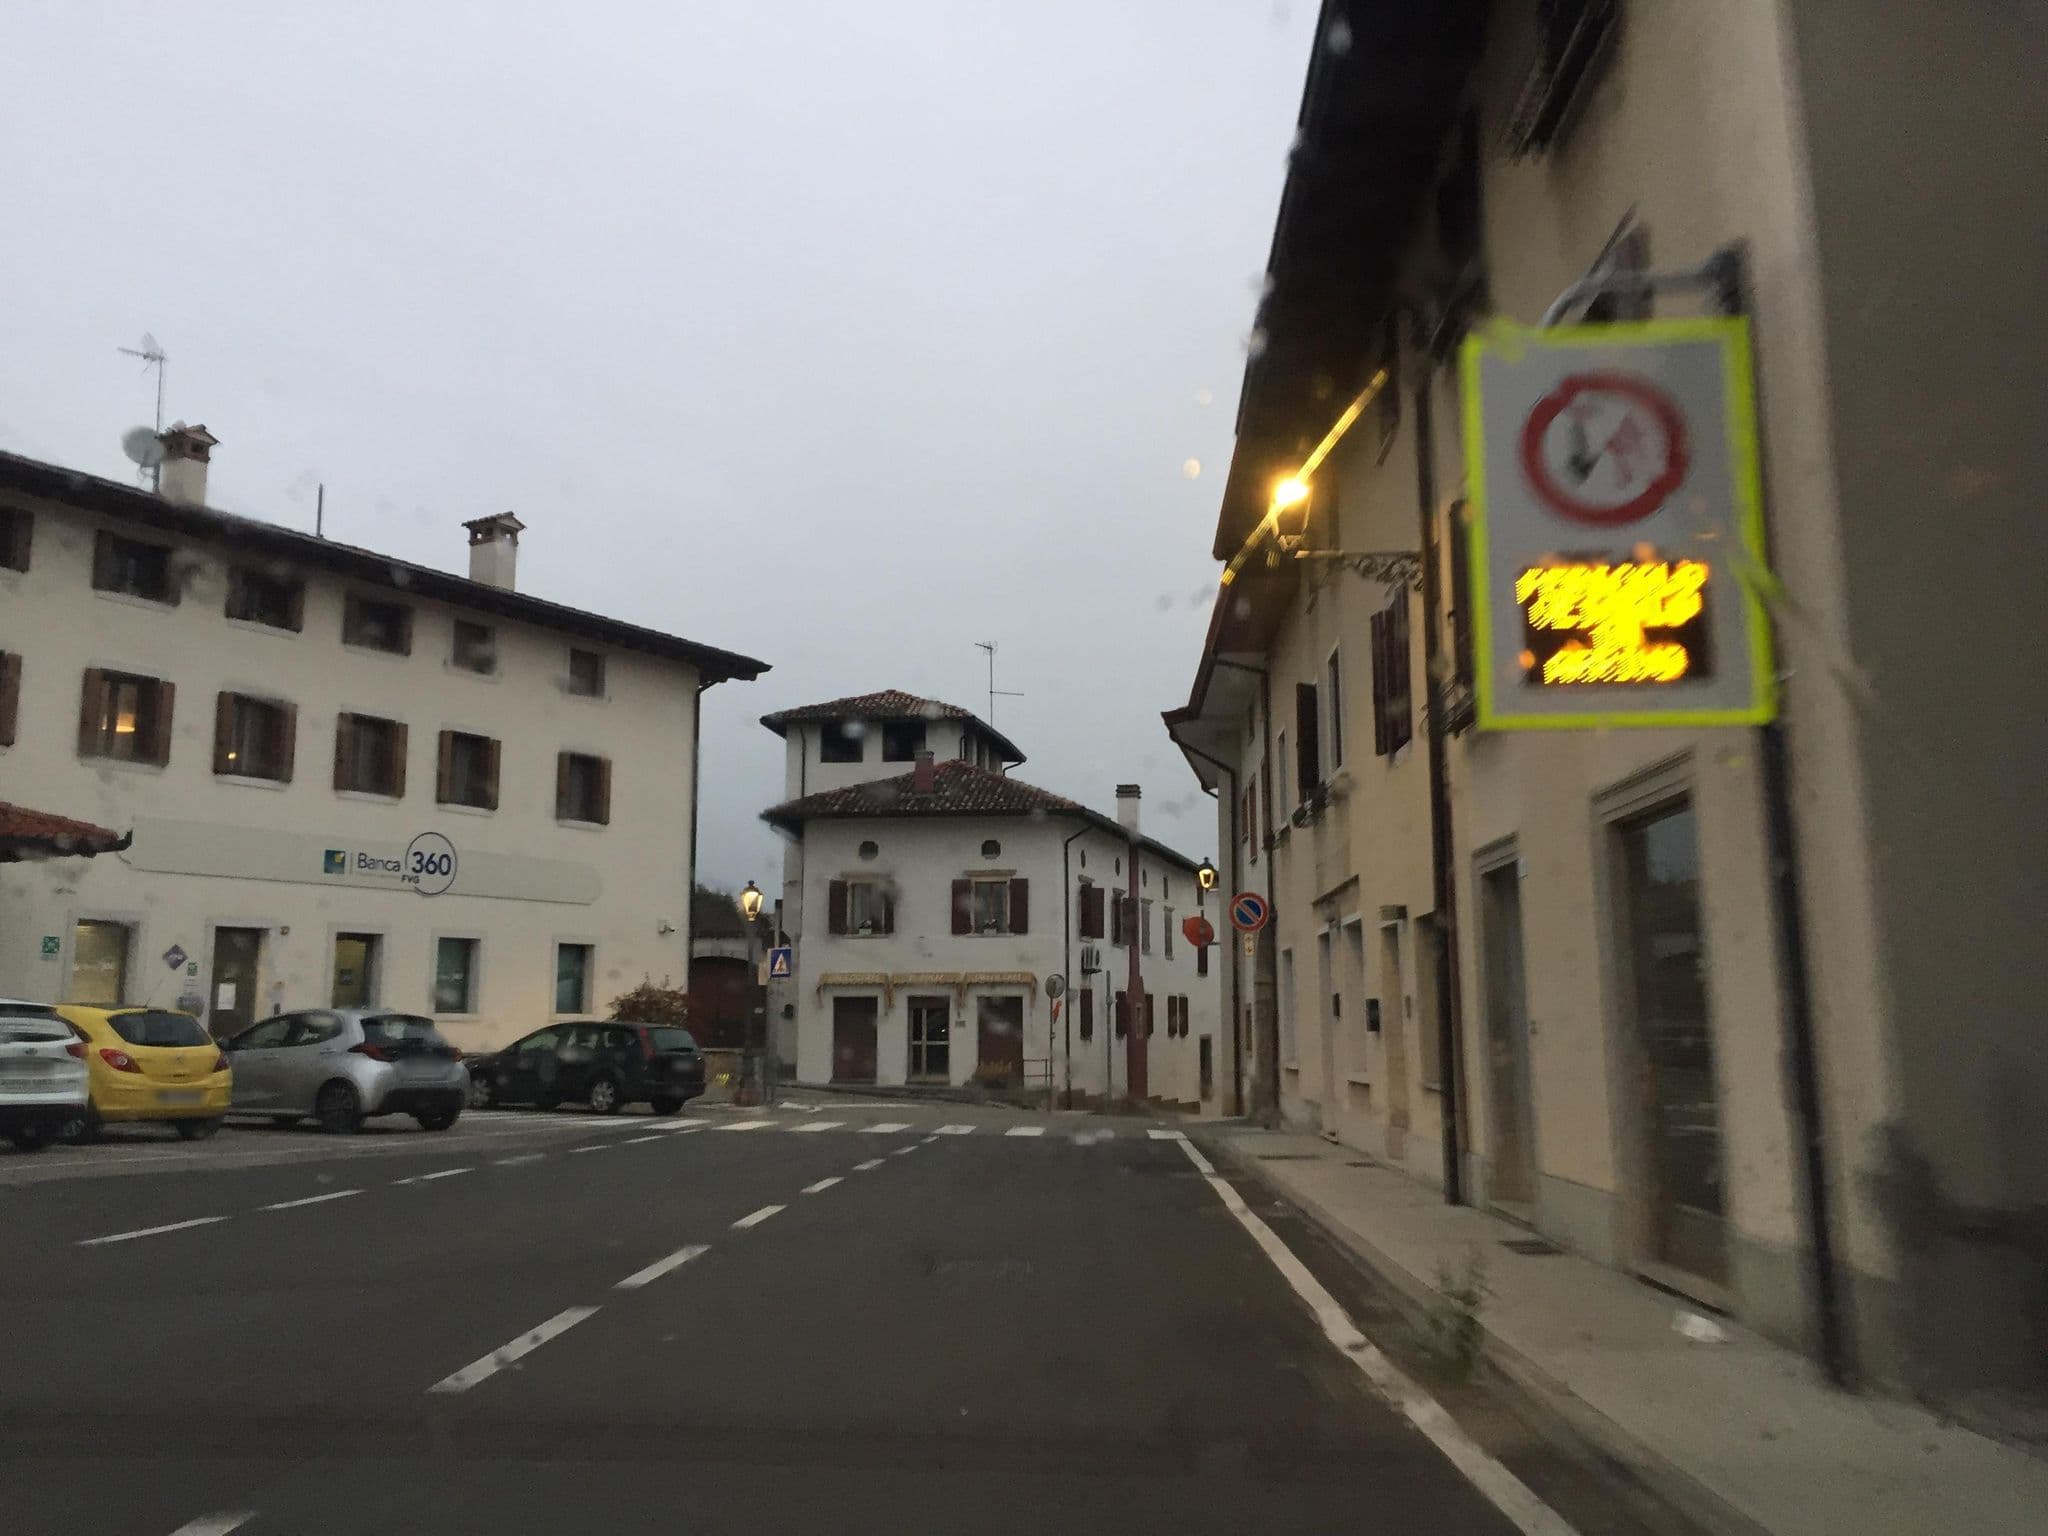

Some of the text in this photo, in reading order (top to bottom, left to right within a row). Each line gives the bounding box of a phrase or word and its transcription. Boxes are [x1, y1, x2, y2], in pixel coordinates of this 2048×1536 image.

[358, 851, 451, 876] Banca 360
[401, 875, 420, 884] FVG
